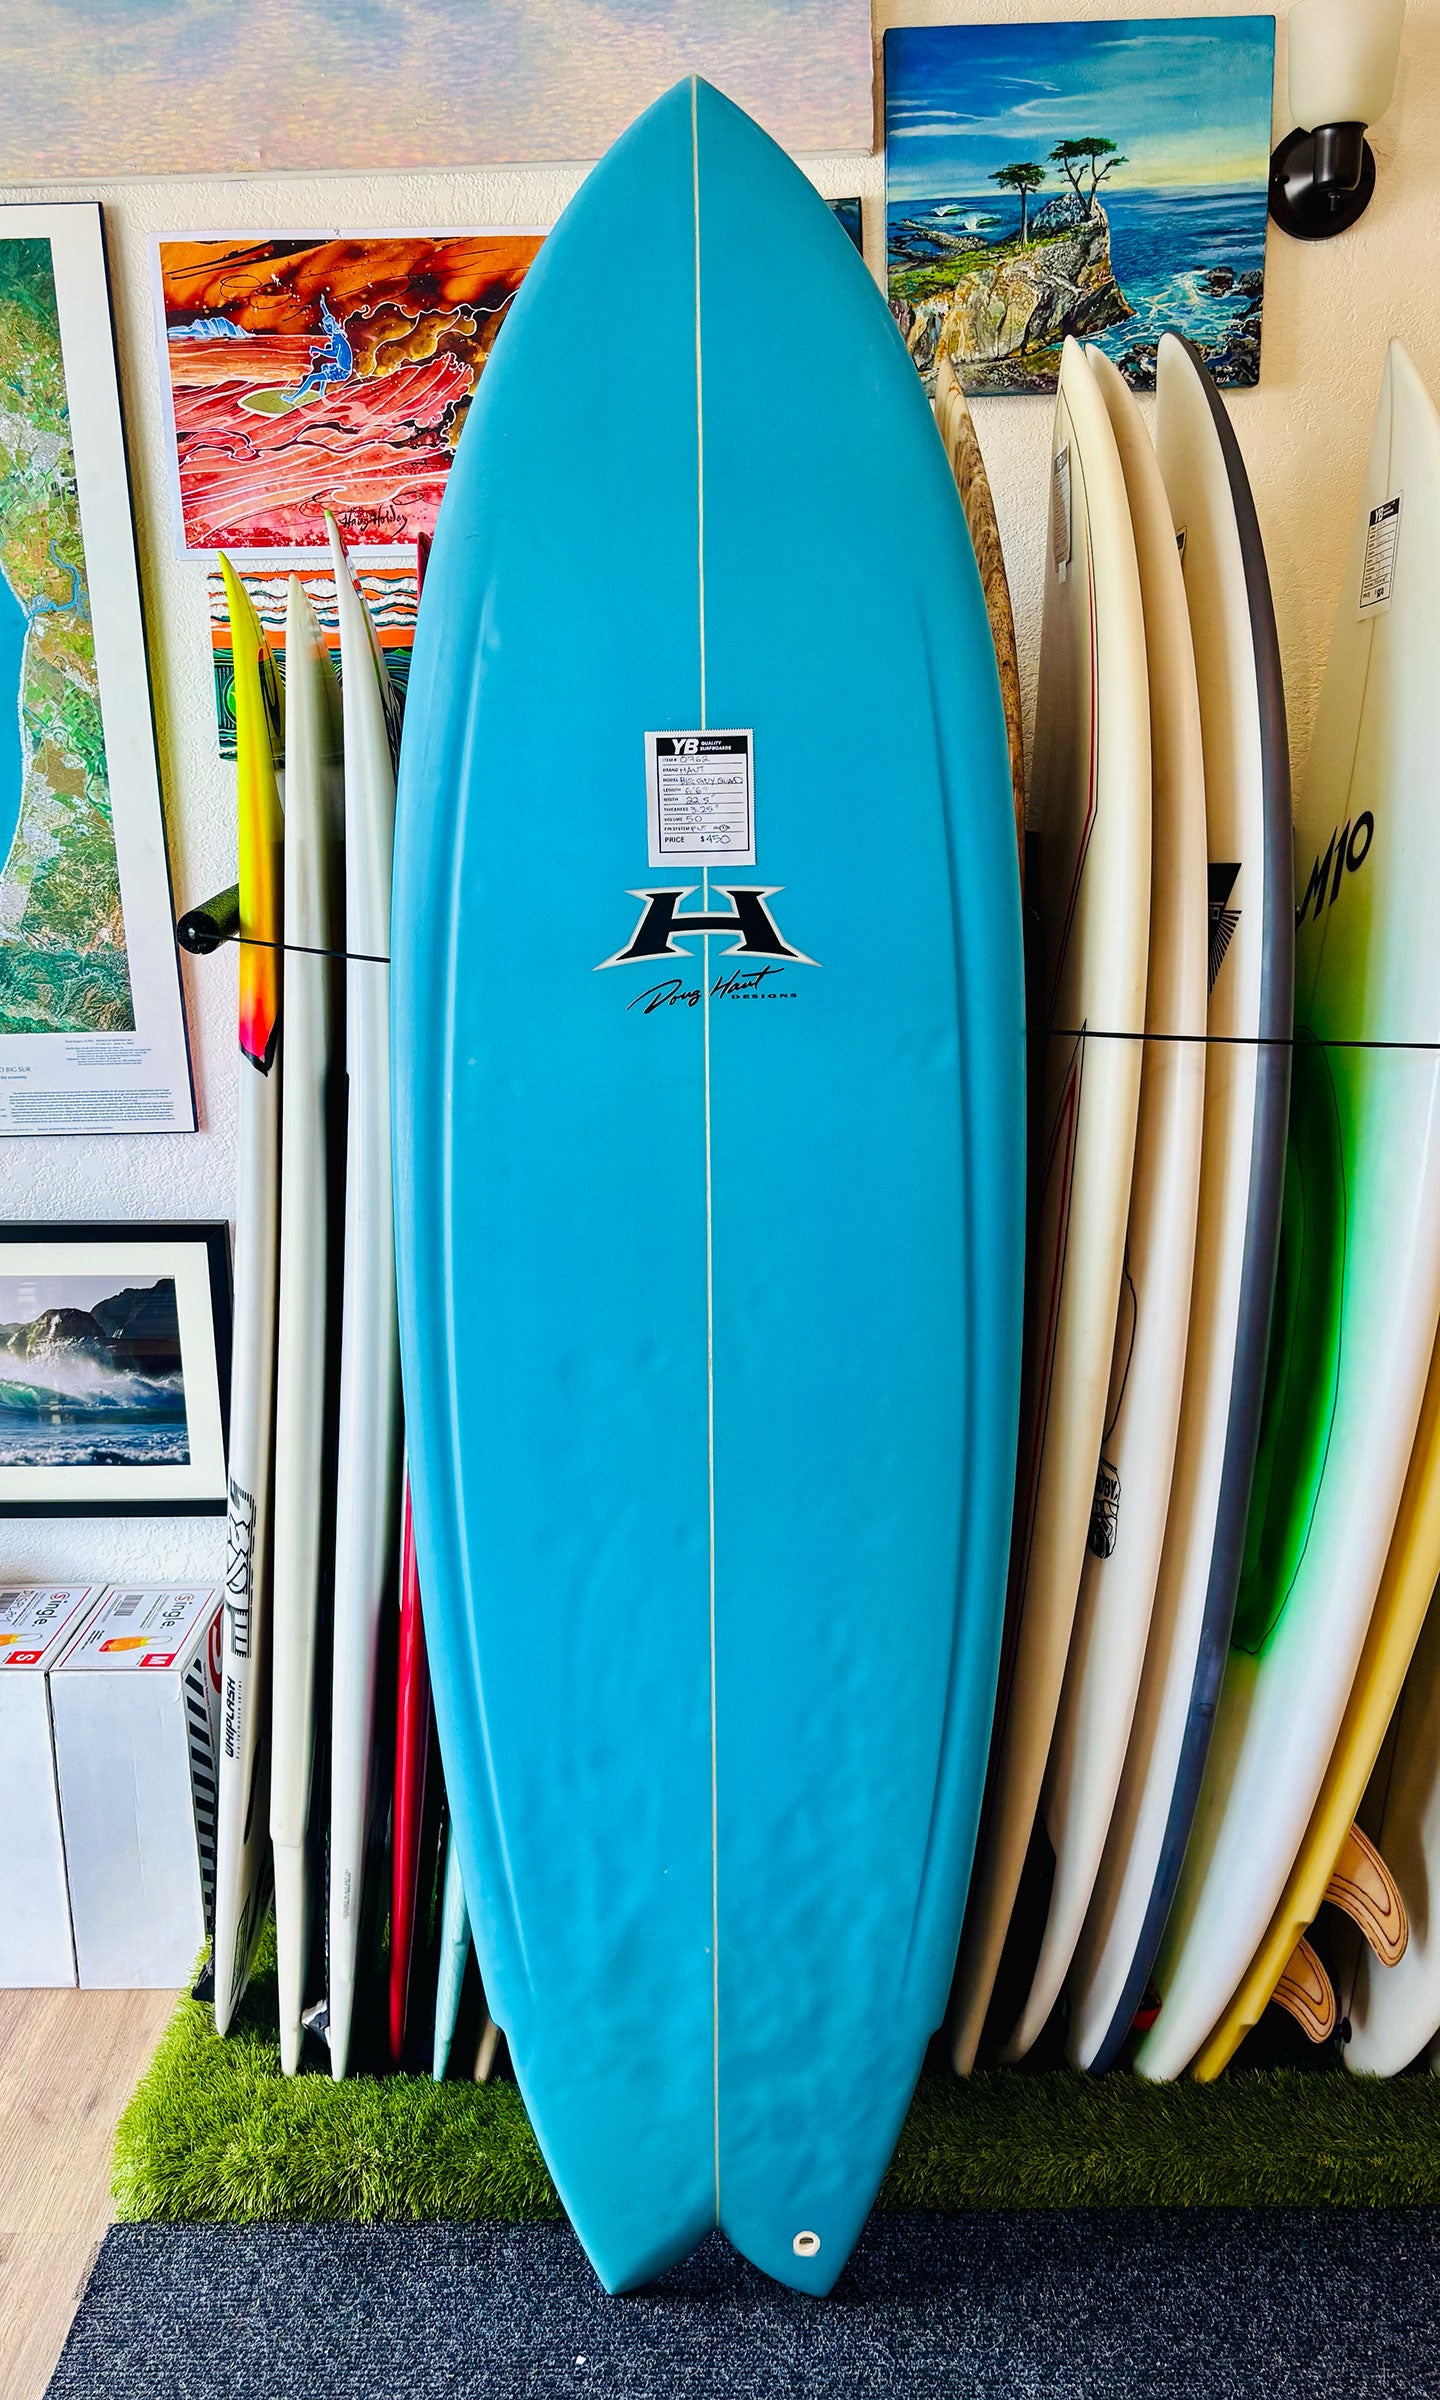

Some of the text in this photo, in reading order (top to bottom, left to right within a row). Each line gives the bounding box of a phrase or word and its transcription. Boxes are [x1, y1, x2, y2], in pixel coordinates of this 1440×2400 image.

[672, 738, 699, 755] YB
[680, 755, 710, 763] 0762
[680, 766, 704, 775] HAUT
[686, 816, 703, 824] 50
[600, 887, 815, 966] H
[627, 965, 784, 1014] Doug Haut
[16, 1654, 34, 1662] S
[147, 1656, 169, 1665] M
[225, 1674, 237, 1759] WHIPLASH
